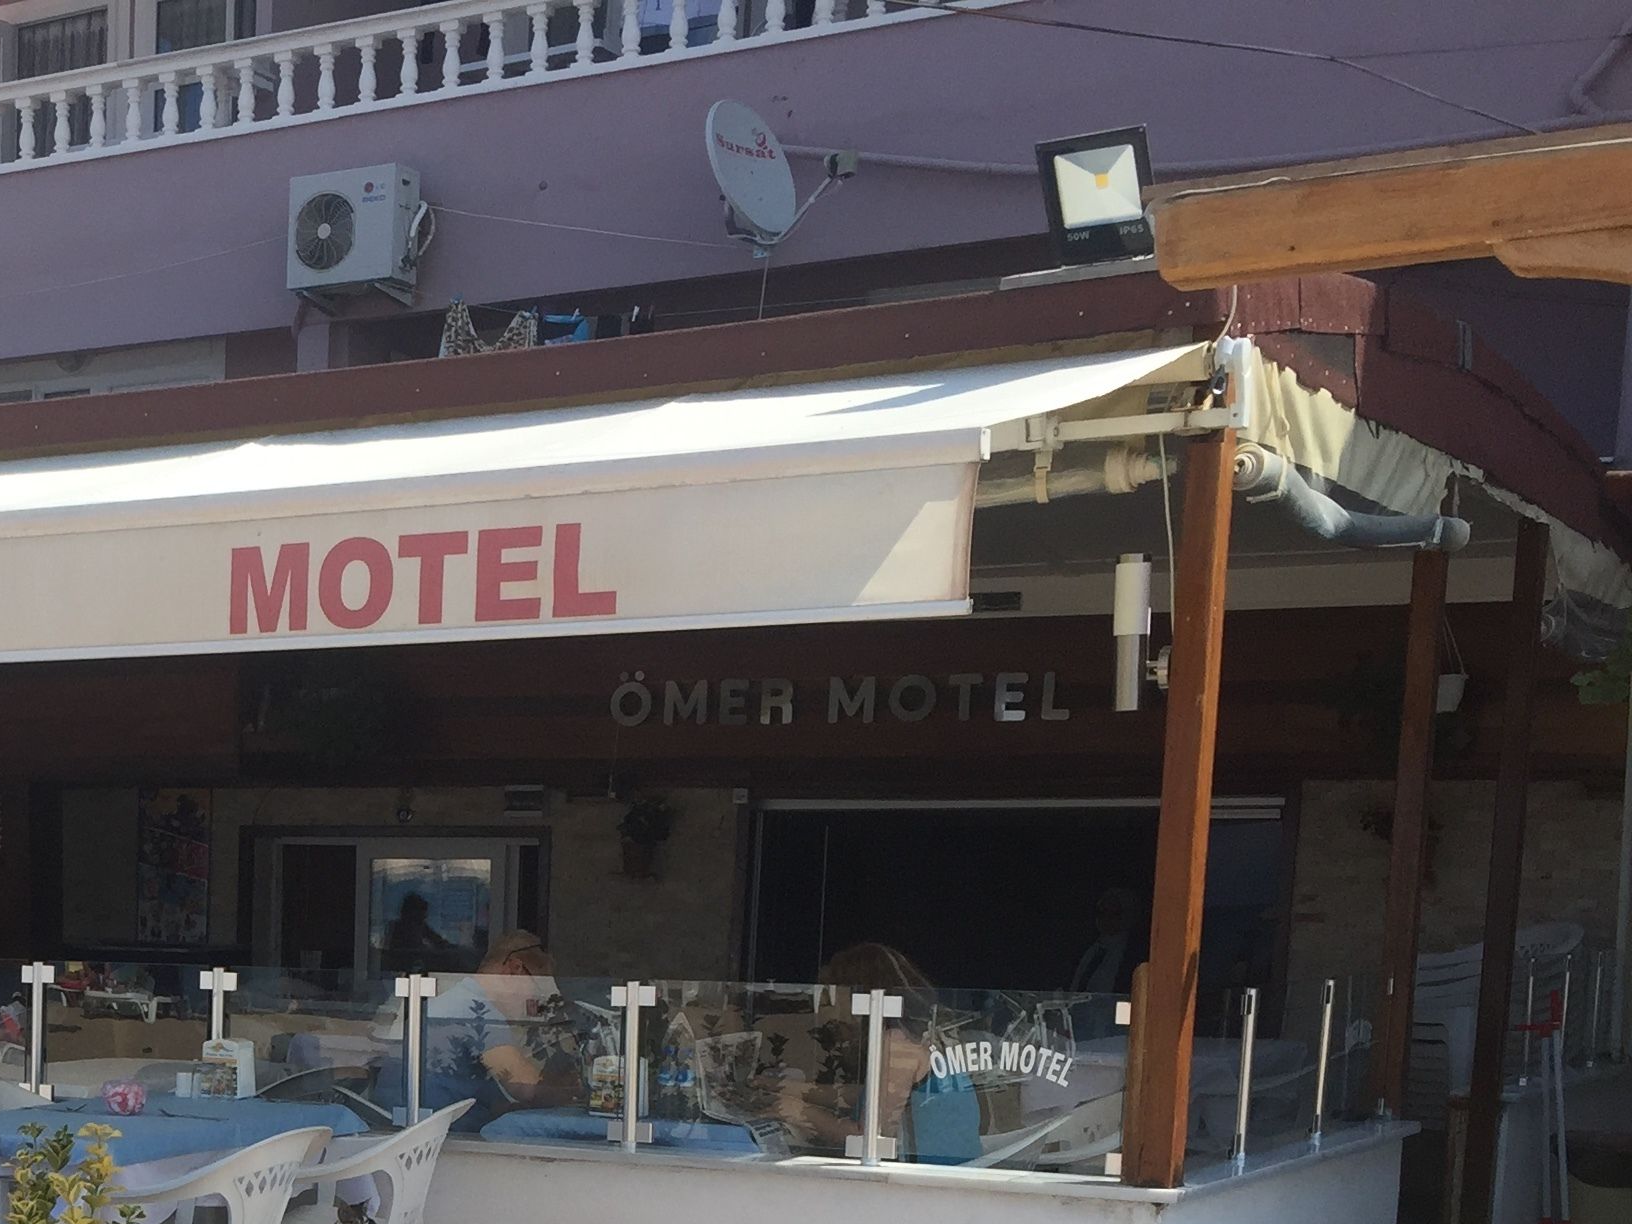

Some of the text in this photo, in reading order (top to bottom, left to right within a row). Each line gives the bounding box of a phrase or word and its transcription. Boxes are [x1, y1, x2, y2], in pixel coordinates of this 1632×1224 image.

[715, 132, 776, 159] Sursat
[1066, 223, 1144, 242] 50W IP65
[229, 522, 617, 635] MOTEL
[609, 670, 1070, 727] ÖMER MOTEL
[928, 1041, 1073, 1088] ÖMER MOTEL
